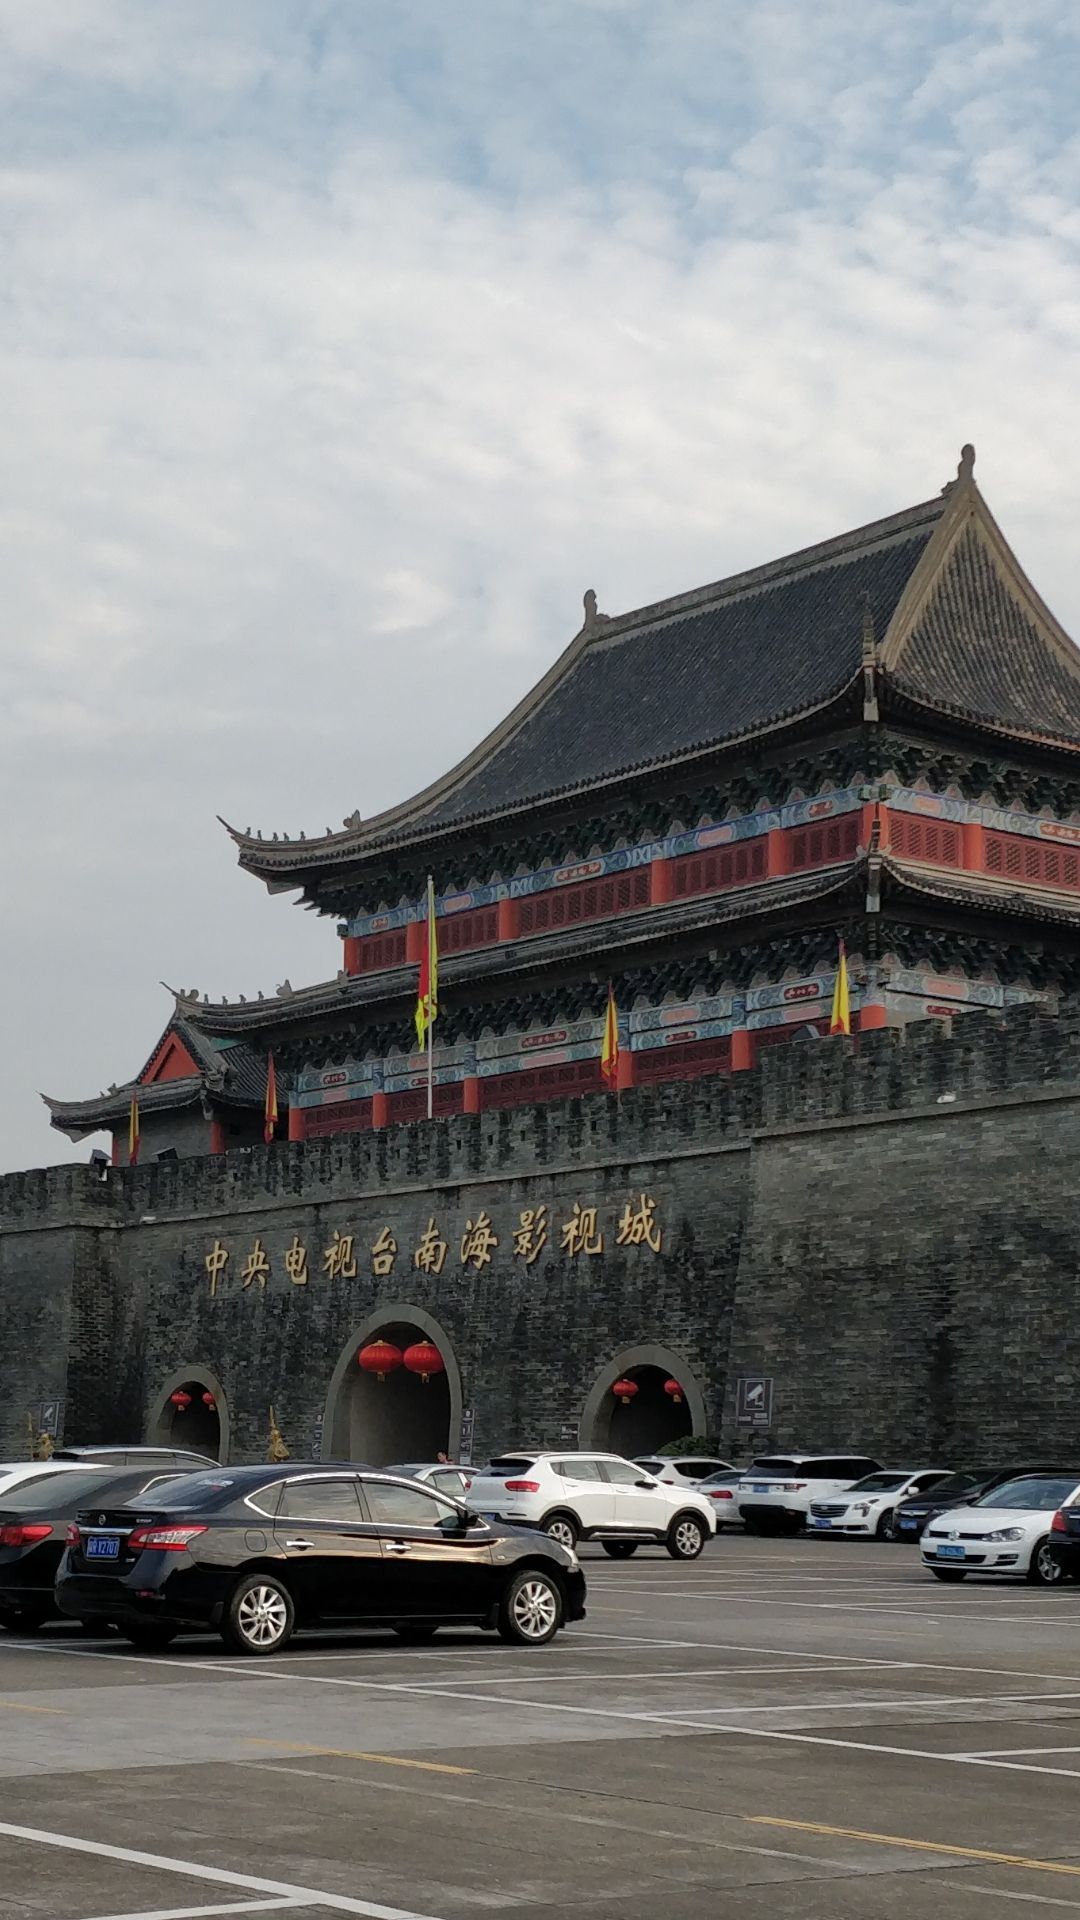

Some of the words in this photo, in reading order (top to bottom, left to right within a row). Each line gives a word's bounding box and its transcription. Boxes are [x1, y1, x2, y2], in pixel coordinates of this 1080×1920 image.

[205, 1193, 663, 1296] 中央电视台南海影视城
